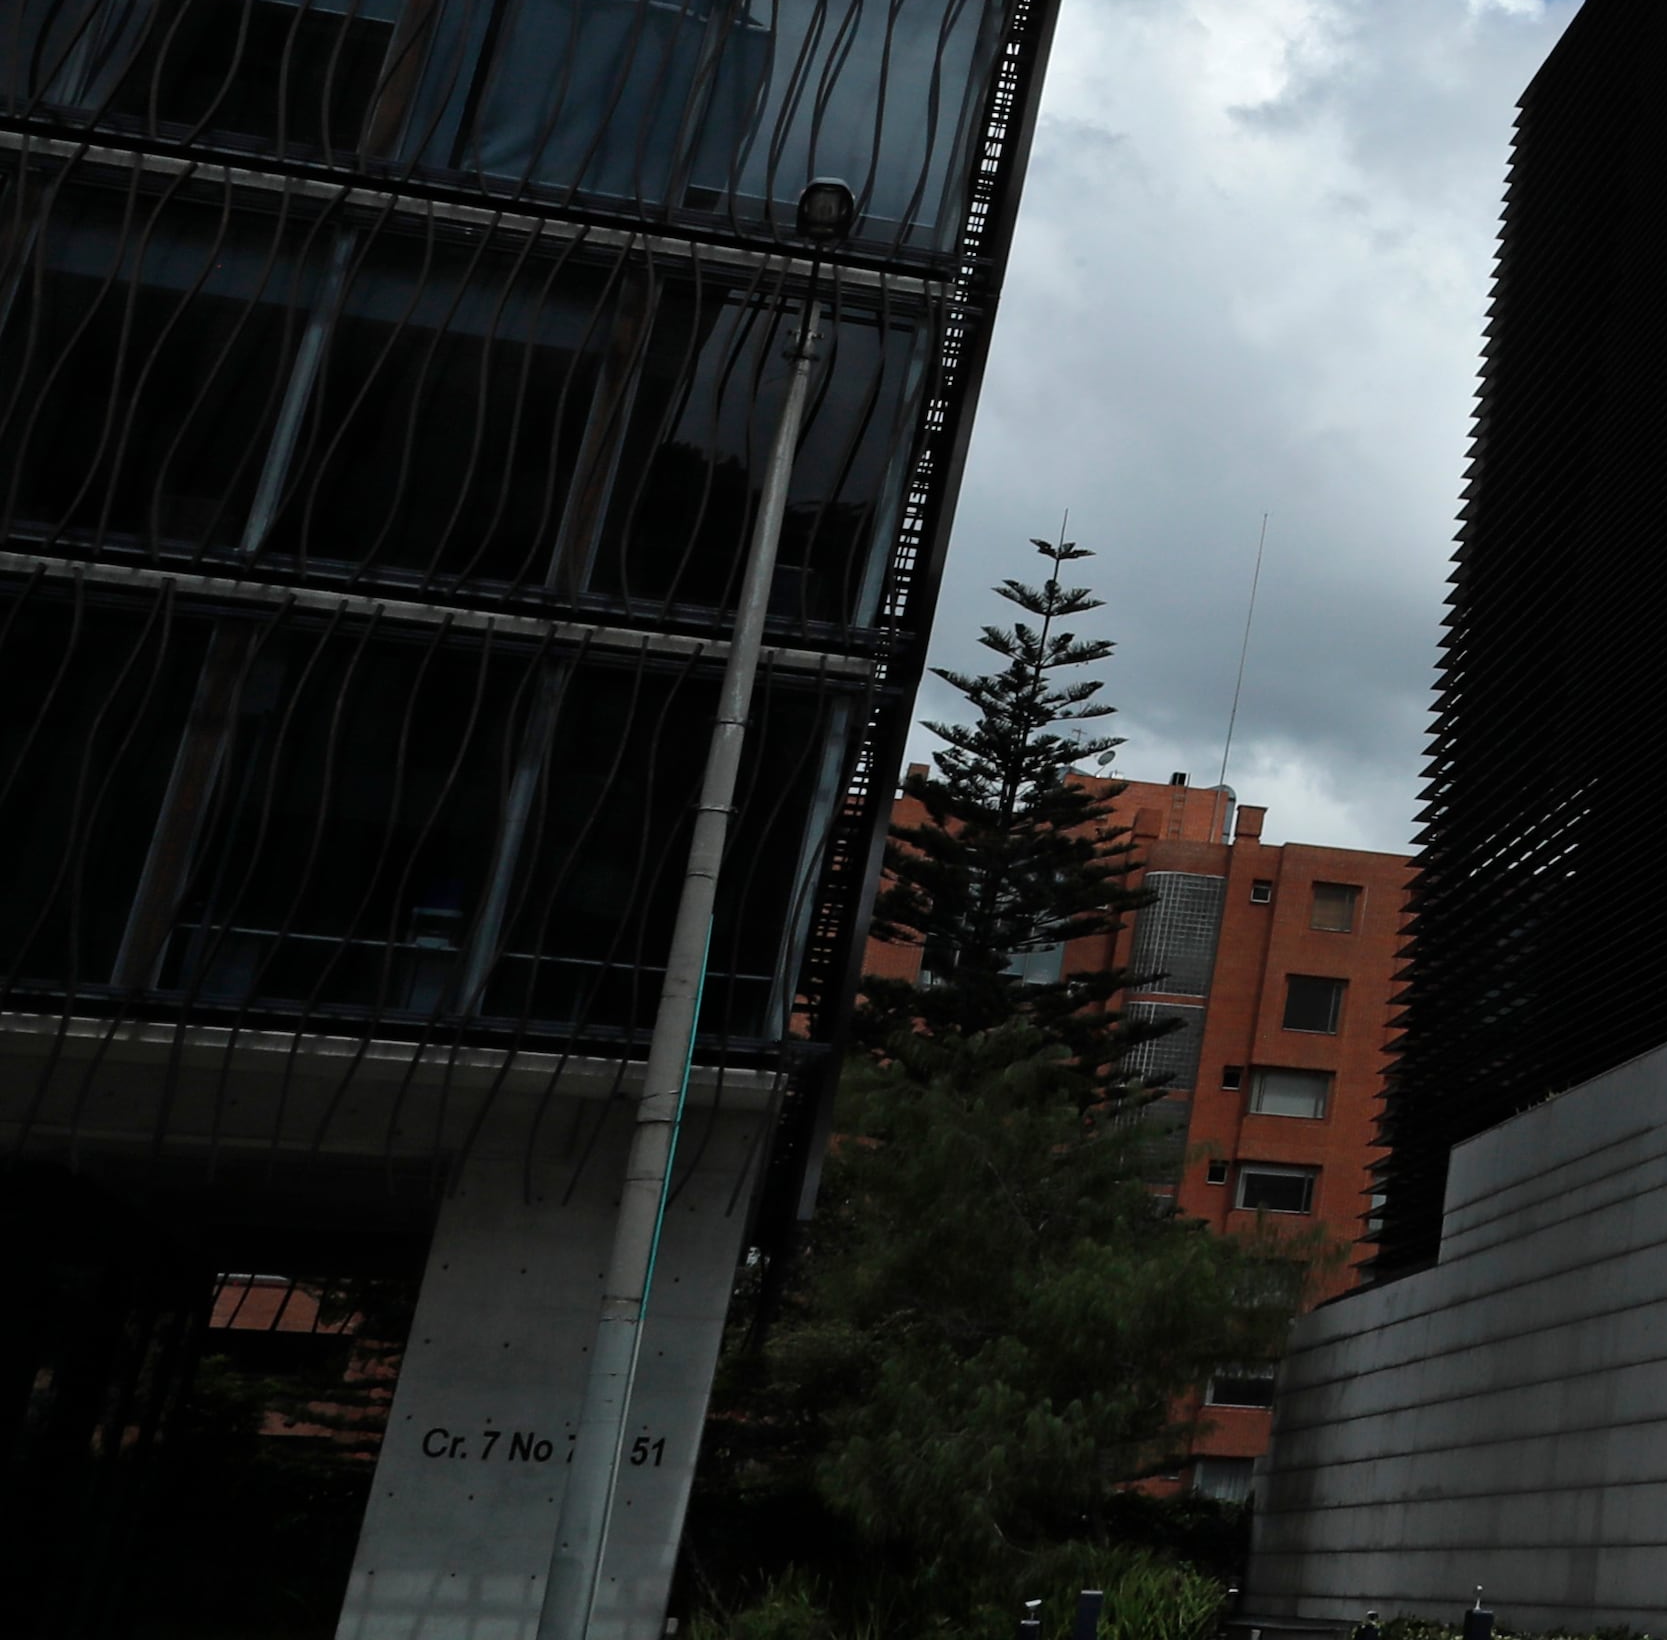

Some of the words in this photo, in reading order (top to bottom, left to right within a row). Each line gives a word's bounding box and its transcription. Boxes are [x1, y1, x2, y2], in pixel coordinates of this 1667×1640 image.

[422, 1428, 467, 1459] Cr.
[481, 1431, 501, 1461] 7
[508, 1432, 553, 1462] No
